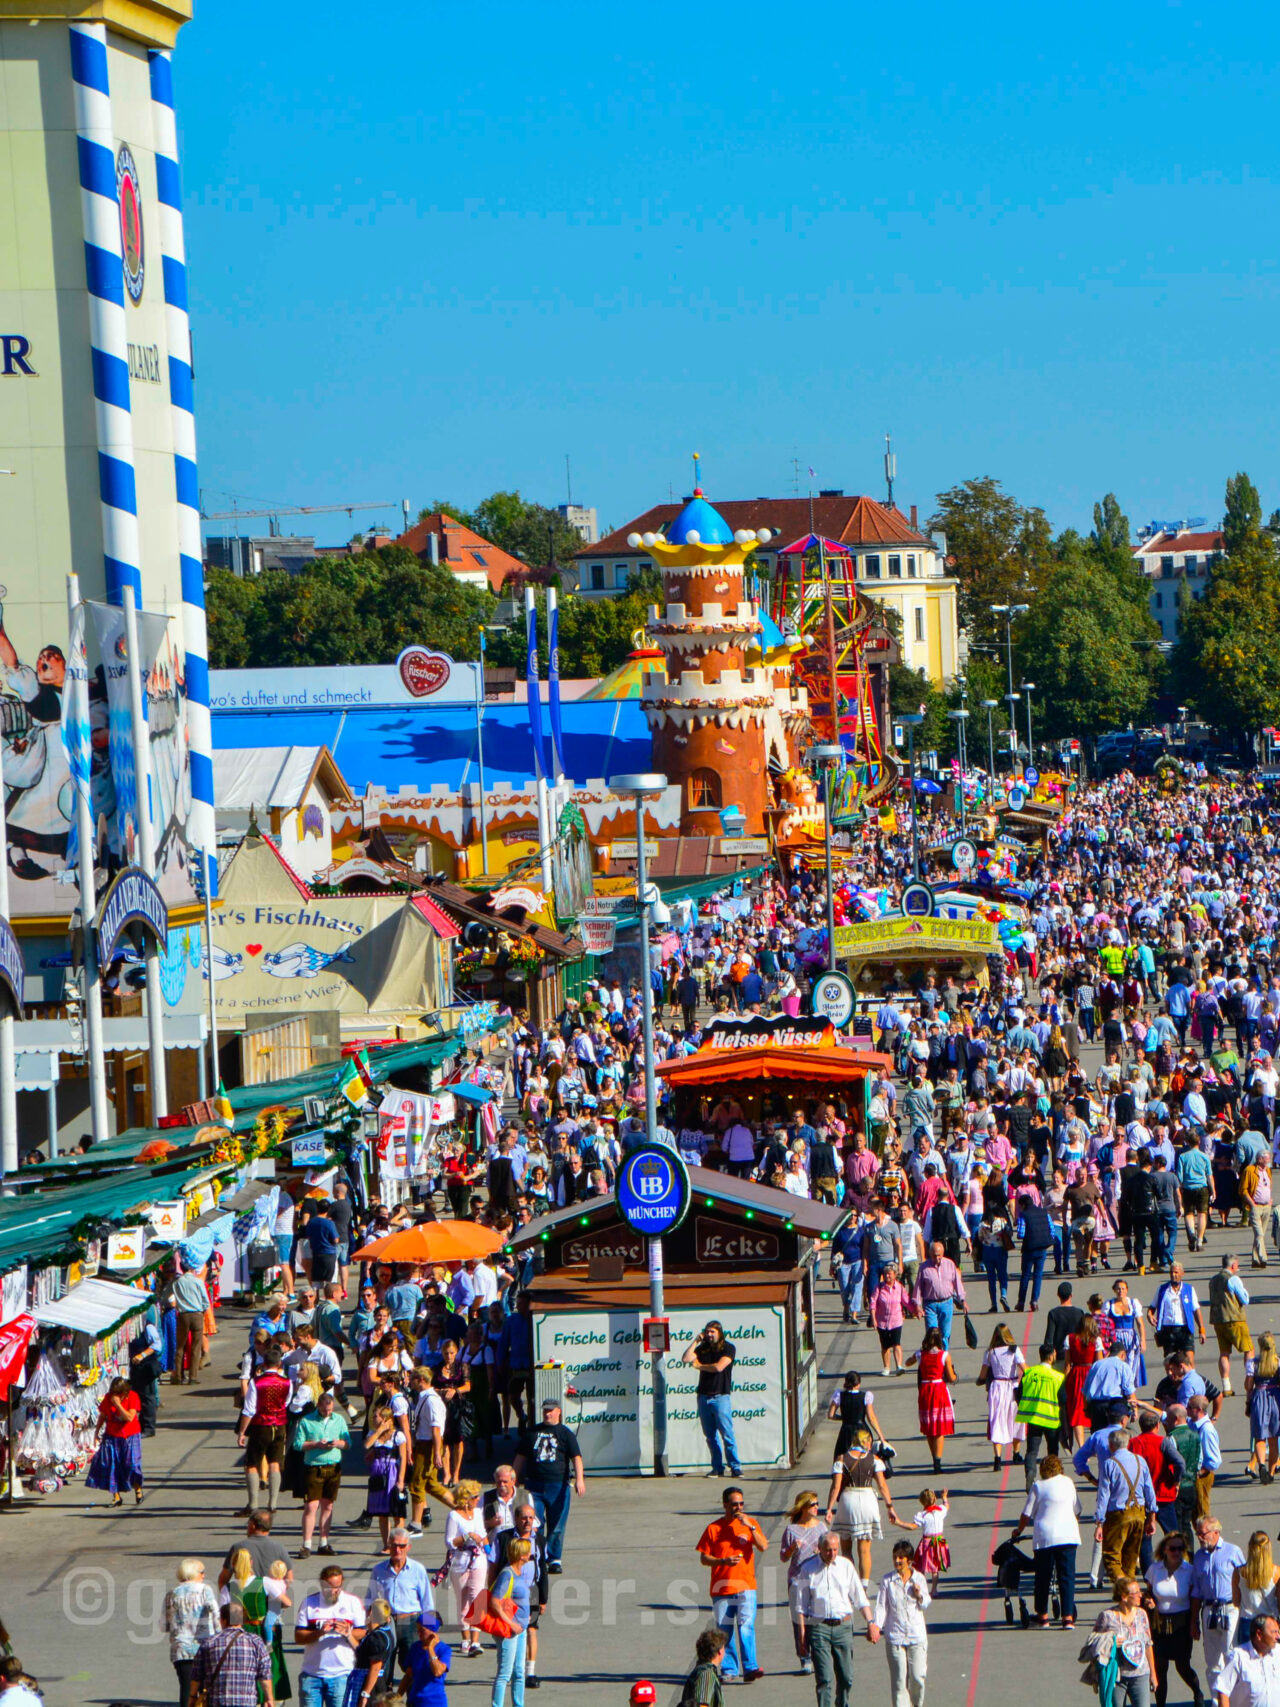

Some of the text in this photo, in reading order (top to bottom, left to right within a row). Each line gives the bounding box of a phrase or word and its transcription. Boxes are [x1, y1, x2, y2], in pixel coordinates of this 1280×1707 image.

[408, 664, 439, 683] Rischart
[241, 689, 277, 706] duftet
[282, 689, 307, 704] und
[312, 687, 372, 703] schmeckt
[587, 902, 595, 910] 26
[101, 875, 167, 966] PAULANERGARTEN
[254, 907, 365, 936] Fischhaus
[834, 924, 897, 943] MANDEL
[242, 994, 302, 1008] scheene
[712, 1027, 823, 1048] Heisse Nüsse
[640, 1176, 664, 1196] HB
[628, 1204, 677, 1220] MÜNCHEN
[703, 1235, 768, 1257] Ecke
[554, 1330, 606, 1346] Frische
[613, 1328, 693, 1345] Gebnte
[566, 1360, 622, 1376] agenbrot
[635, 1359, 650, 1370] Po
[733, 1355, 766, 1368] nüsse
[566, 1385, 626, 1398] acadamia
[565, 1411, 637, 1424] ashewkerne
[731, 1408, 766, 1421] ougat
